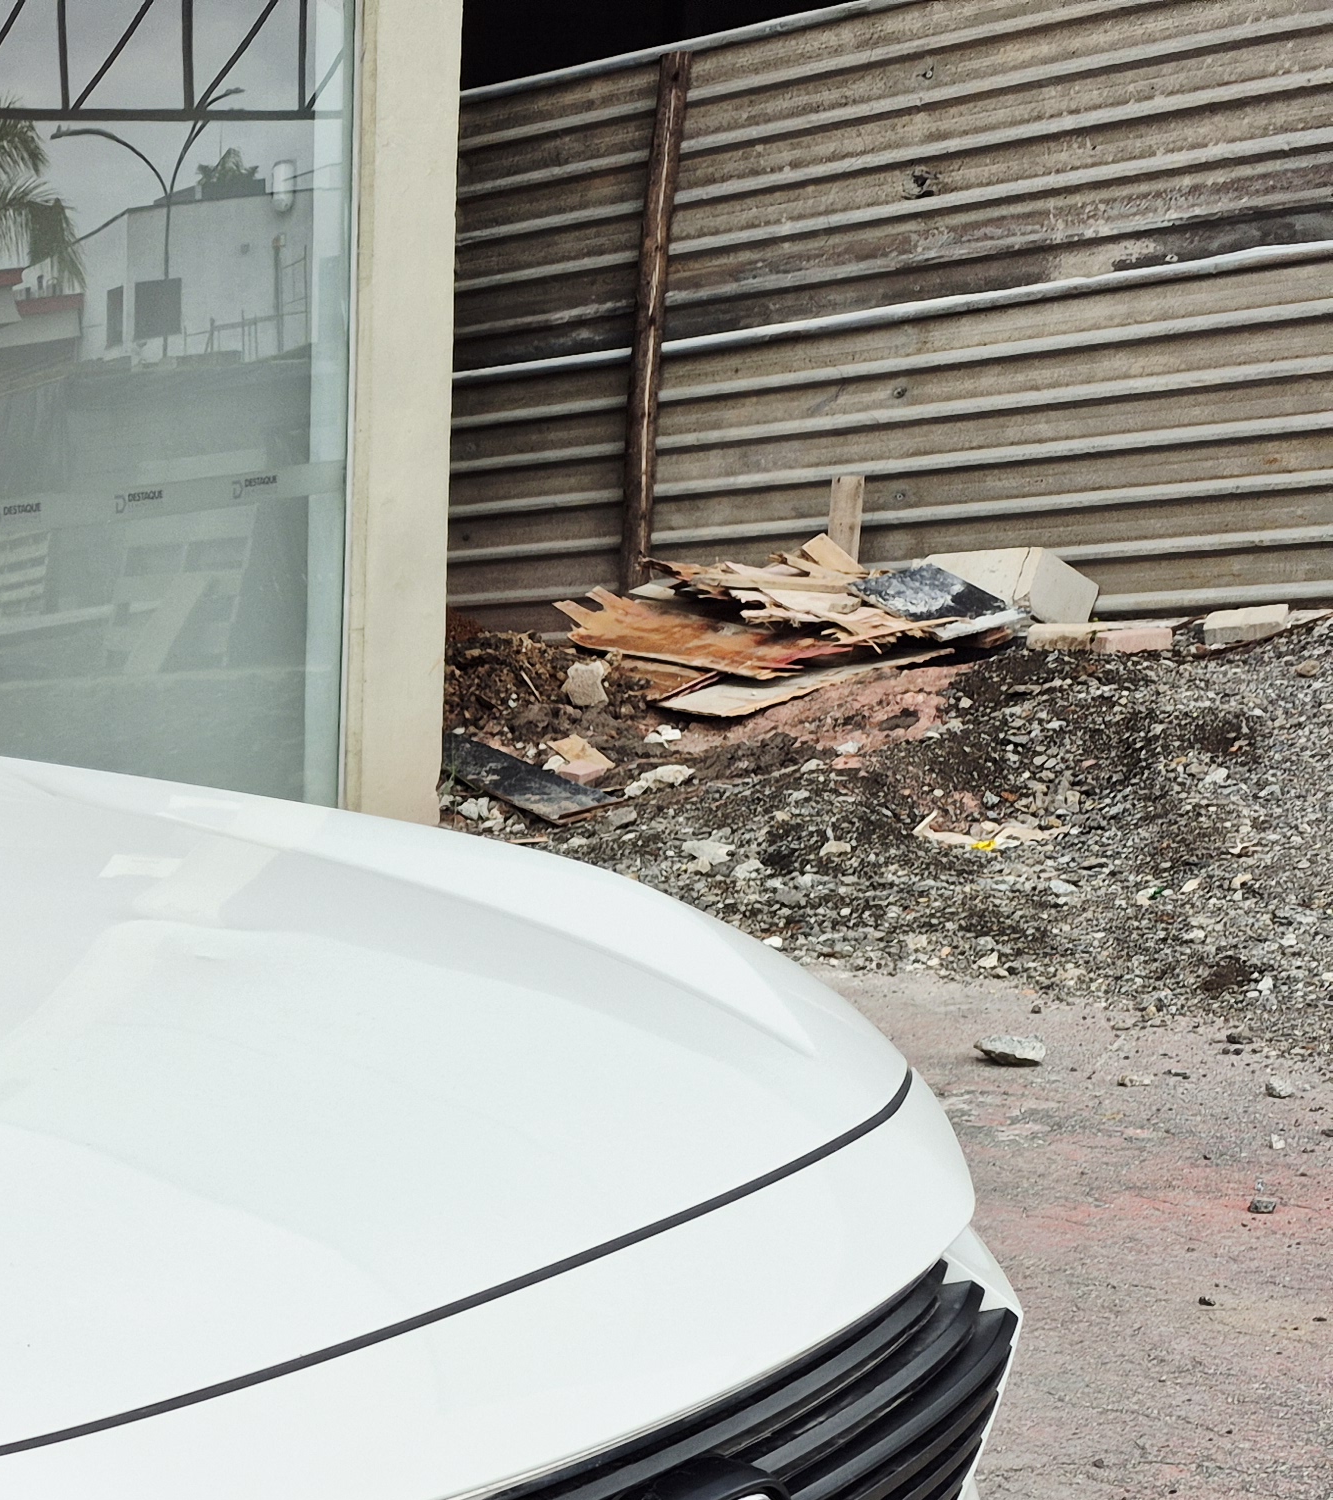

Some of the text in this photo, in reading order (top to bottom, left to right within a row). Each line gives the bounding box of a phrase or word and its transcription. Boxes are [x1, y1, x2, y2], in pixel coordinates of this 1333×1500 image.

[244, 474, 277, 488] DESTAQUE
[128, 489, 163, 502] DESTAQUE
[3, 502, 41, 517] DESTAQUE
